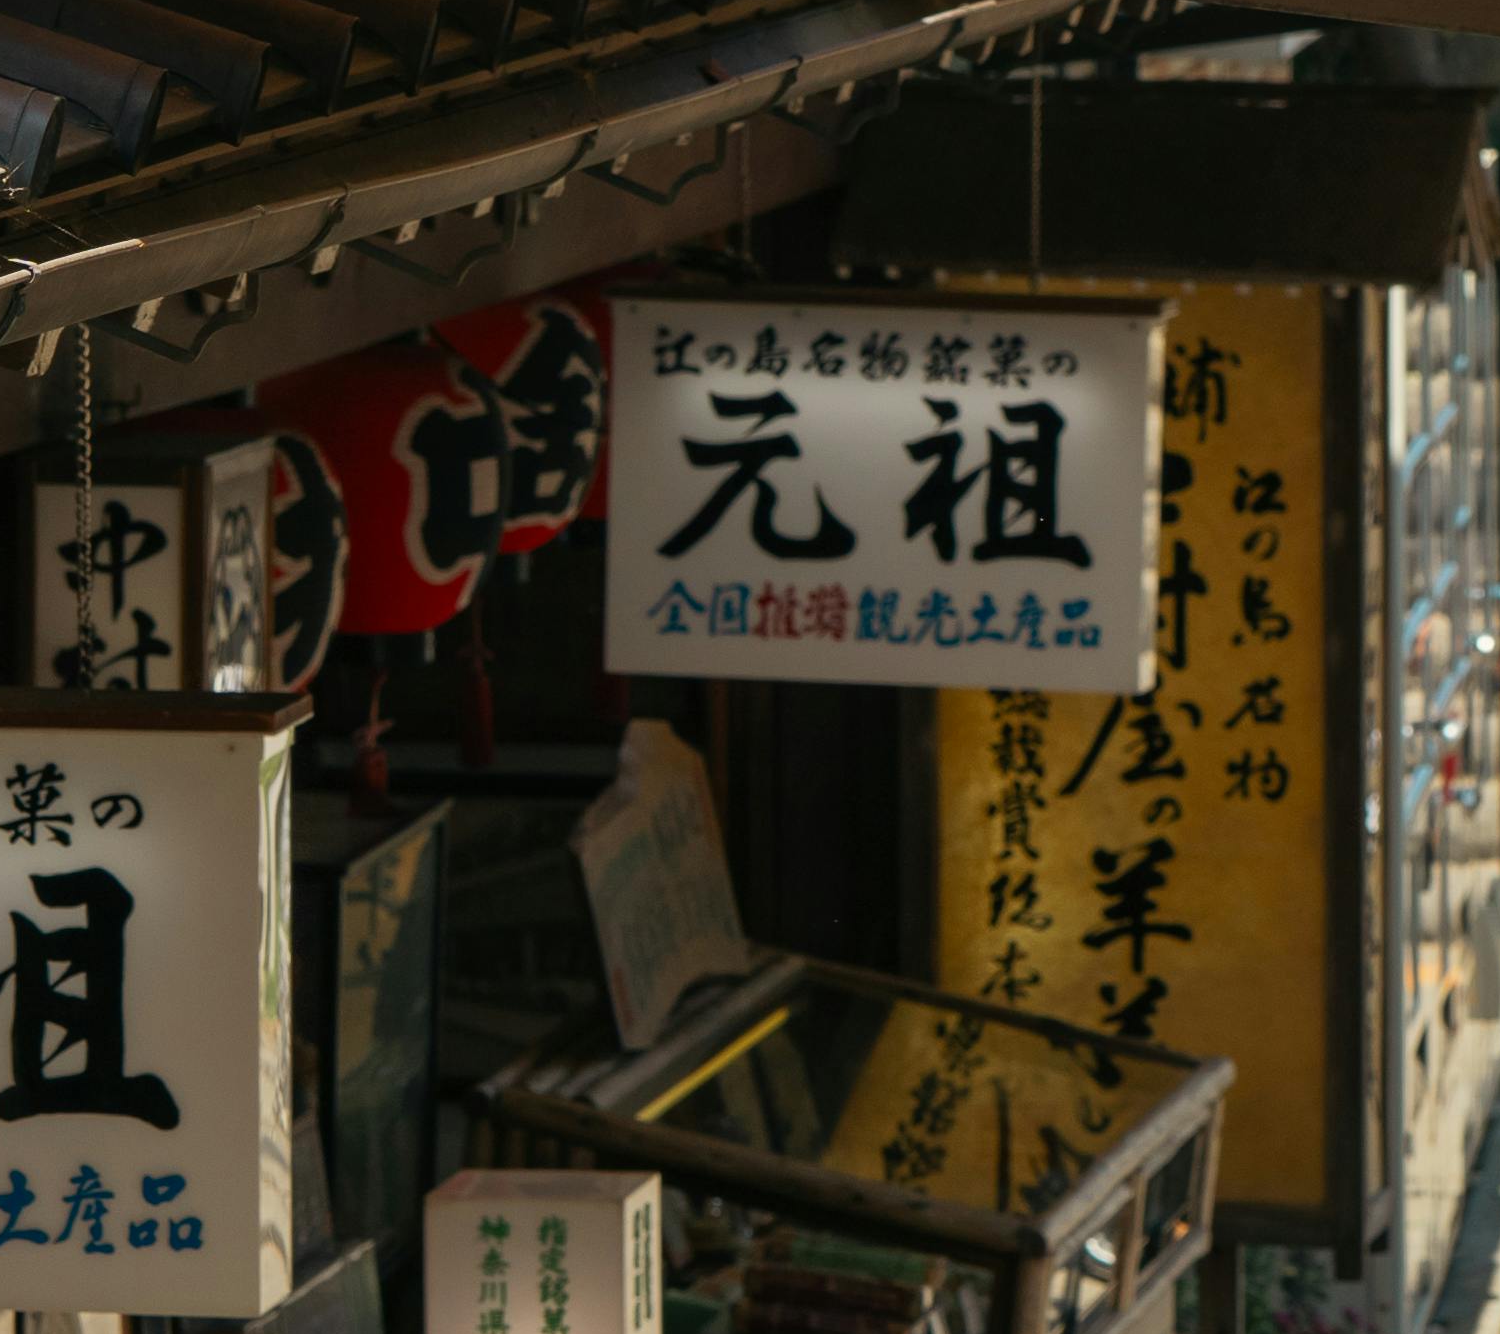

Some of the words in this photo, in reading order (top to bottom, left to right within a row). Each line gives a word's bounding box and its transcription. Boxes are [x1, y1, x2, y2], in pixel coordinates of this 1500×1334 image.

[653, 324, 1078, 387] 江の島名物銘菓の
[658, 390, 1092, 568] 元祖
[648, 578, 1102, 650] 全国推奨観光土産品
